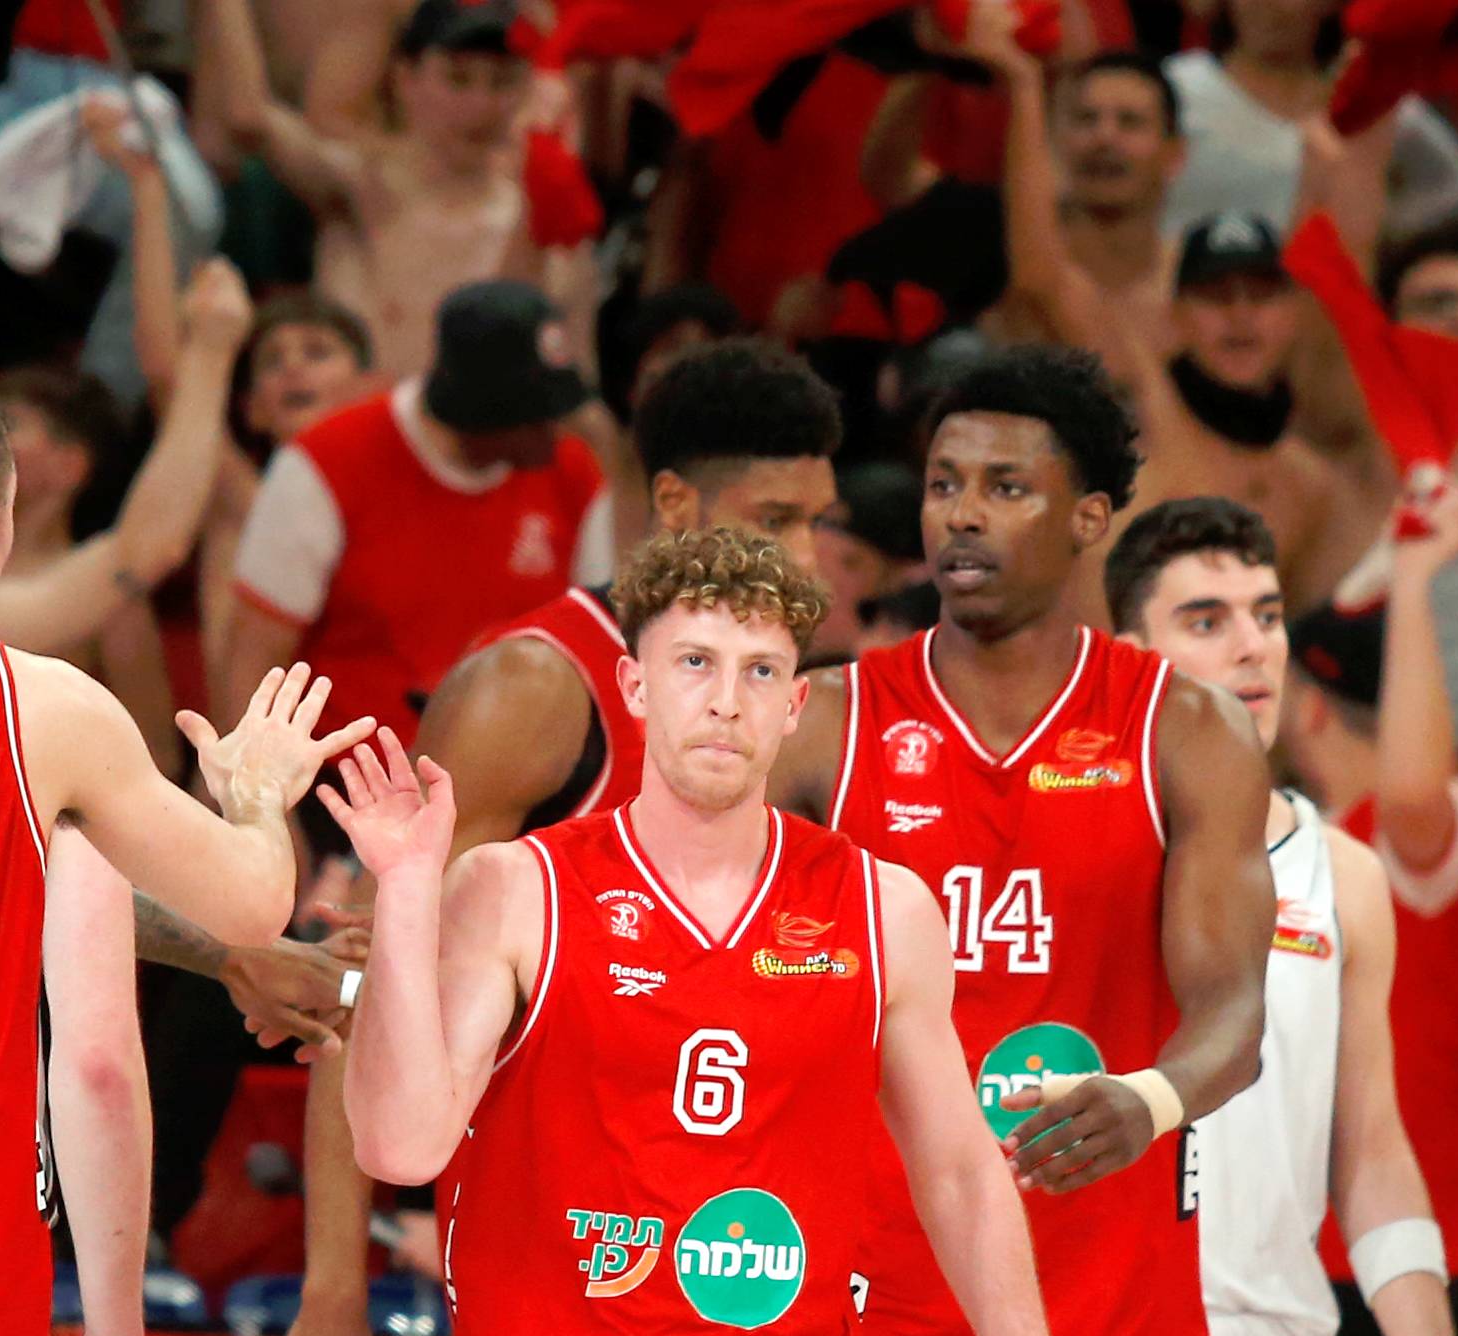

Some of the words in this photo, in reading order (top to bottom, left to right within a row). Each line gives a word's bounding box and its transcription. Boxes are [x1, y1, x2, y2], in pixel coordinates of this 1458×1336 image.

[884, 800, 943, 817] Reebok
[943, 864, 1053, 974] 14
[608, 962, 667, 984] Reebok
[766, 957, 831, 974] Winner
[672, 1028, 749, 1136] 6
[566, 1208, 664, 1247] תמיד
[680, 1238, 800, 1280] שלמה
